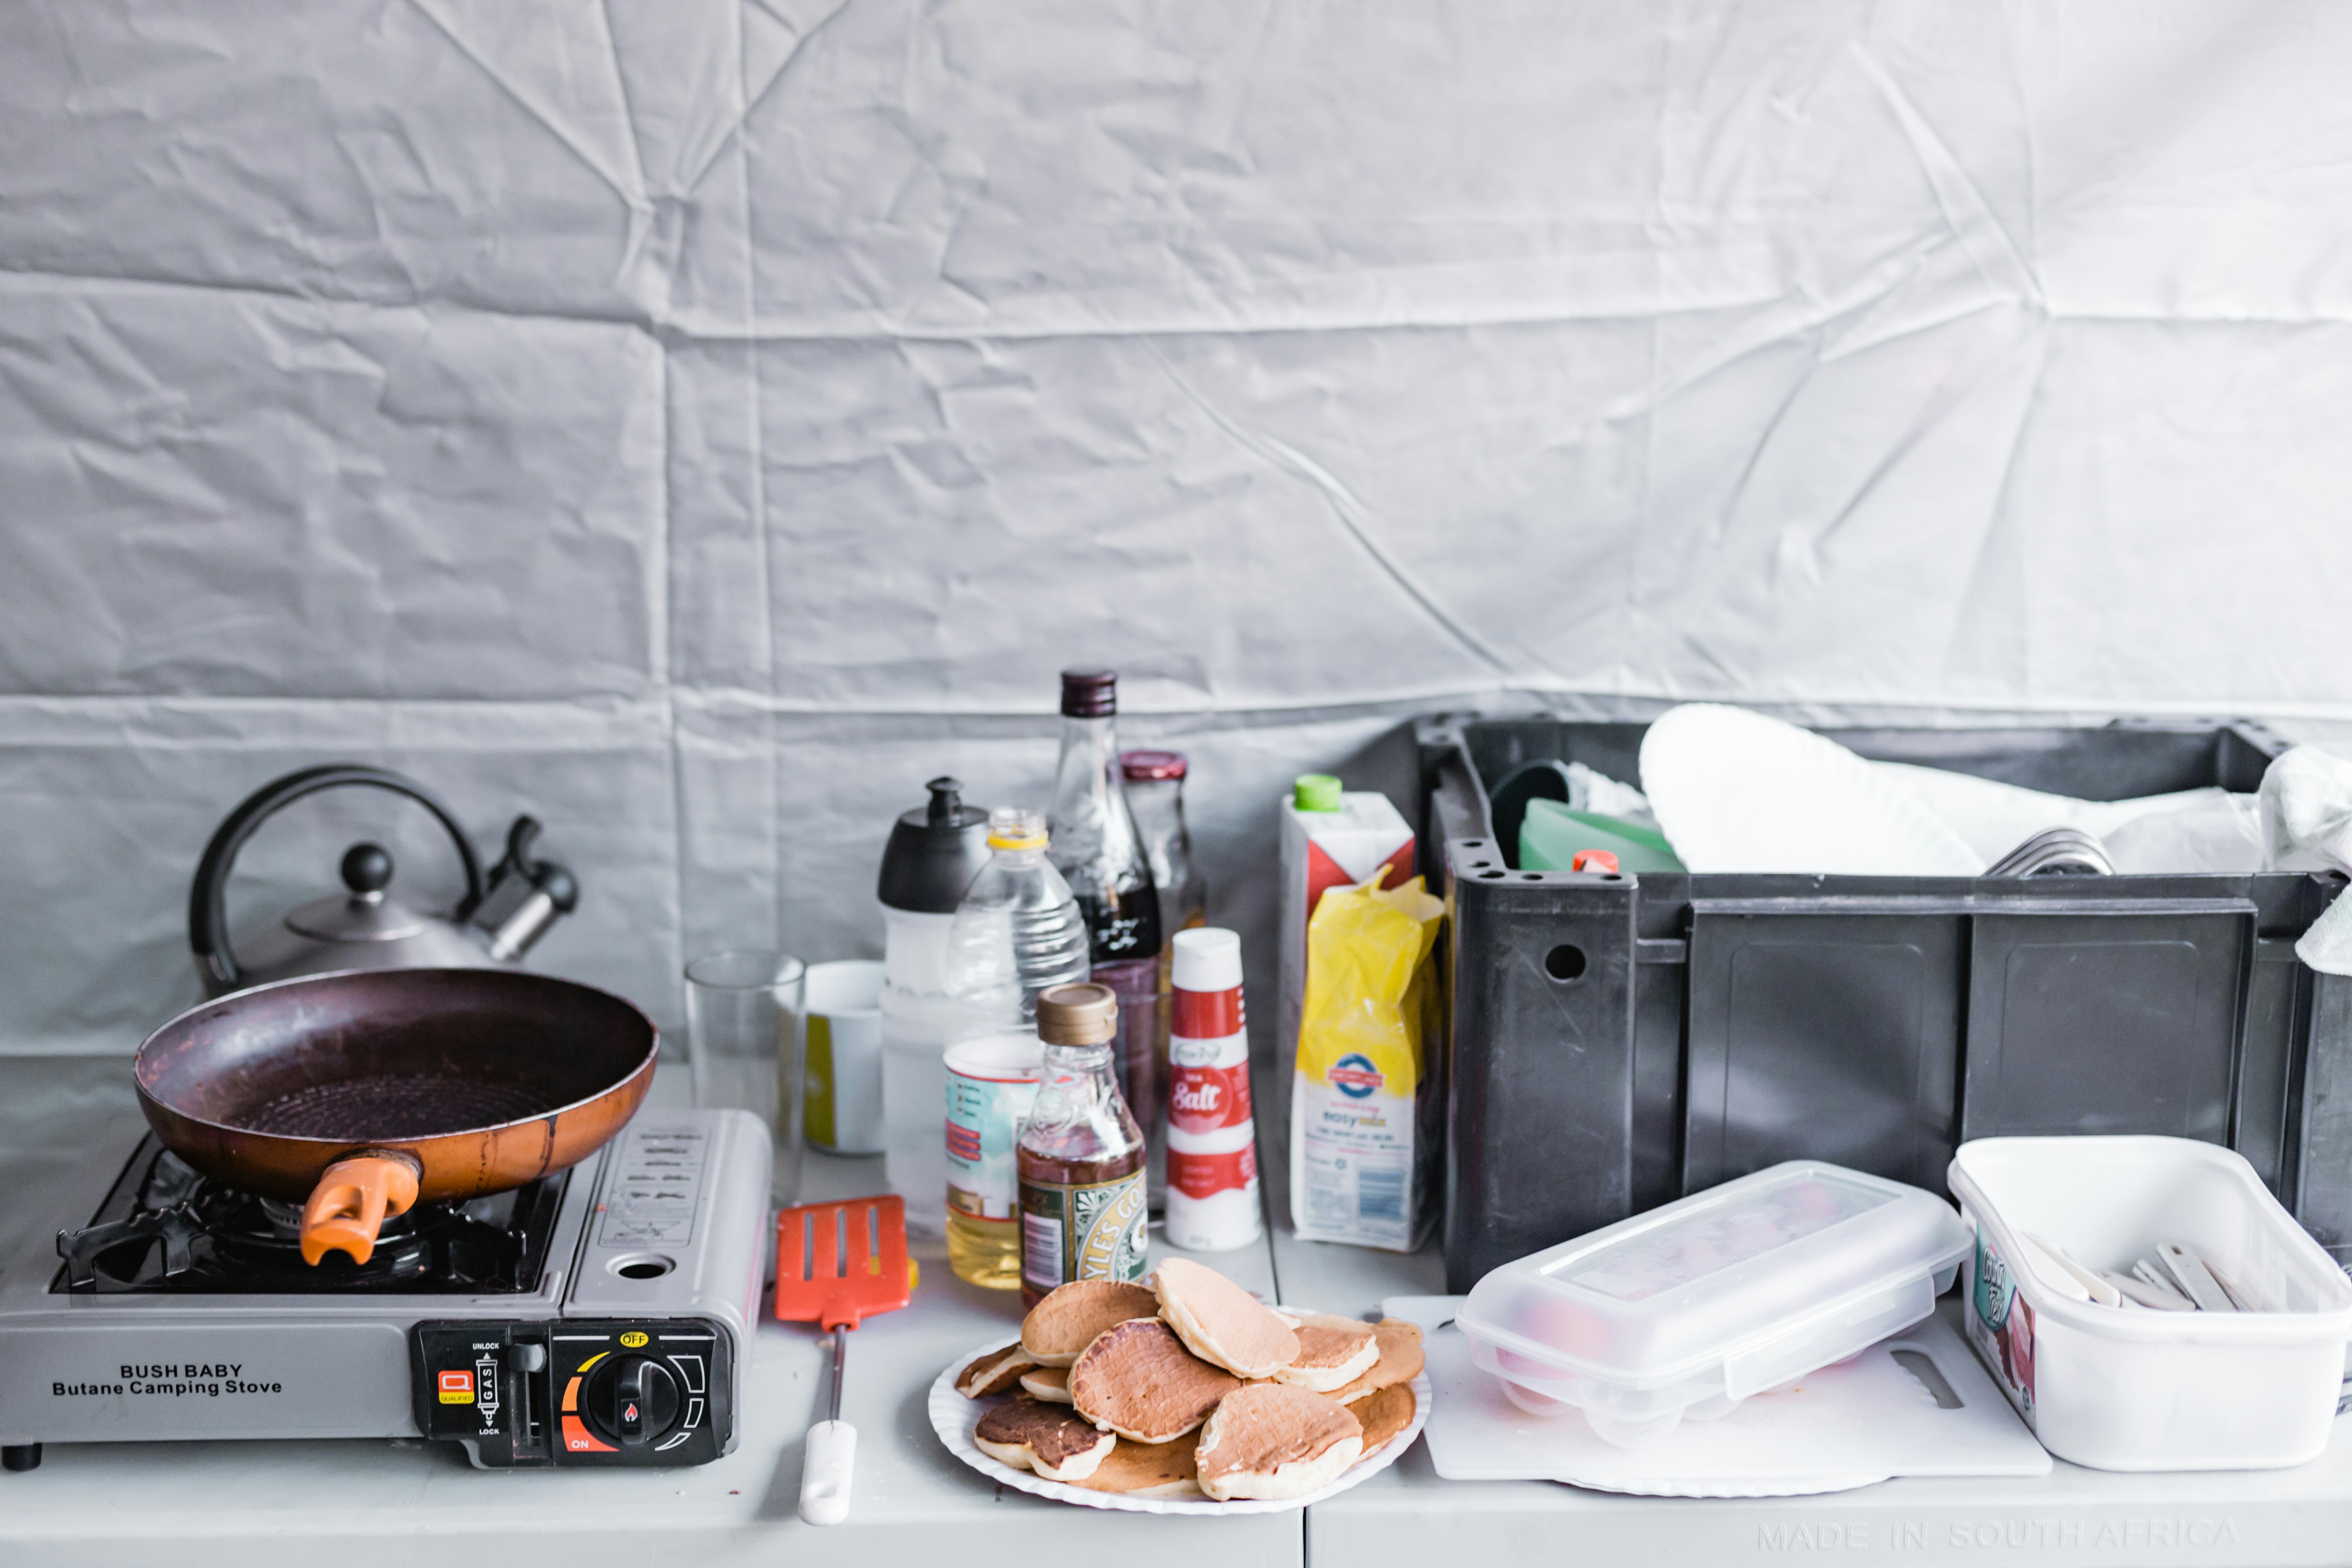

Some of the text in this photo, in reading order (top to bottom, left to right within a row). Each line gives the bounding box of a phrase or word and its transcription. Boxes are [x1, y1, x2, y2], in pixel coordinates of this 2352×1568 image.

[1173, 1081, 1222, 1111] Salt
[1084, 1220, 1121, 1281] YLE'S
[623, 1334, 645, 1344] OFF
[120, 1364, 242, 1378] BUSH BABY
[52, 1380, 282, 1396] Butane Camping Stove
[483, 1369, 493, 1400] GAS
[571, 1440, 589, 1449] ON
[1758, 1516, 2241, 1551] MADE IN SOUTH AFRICA
